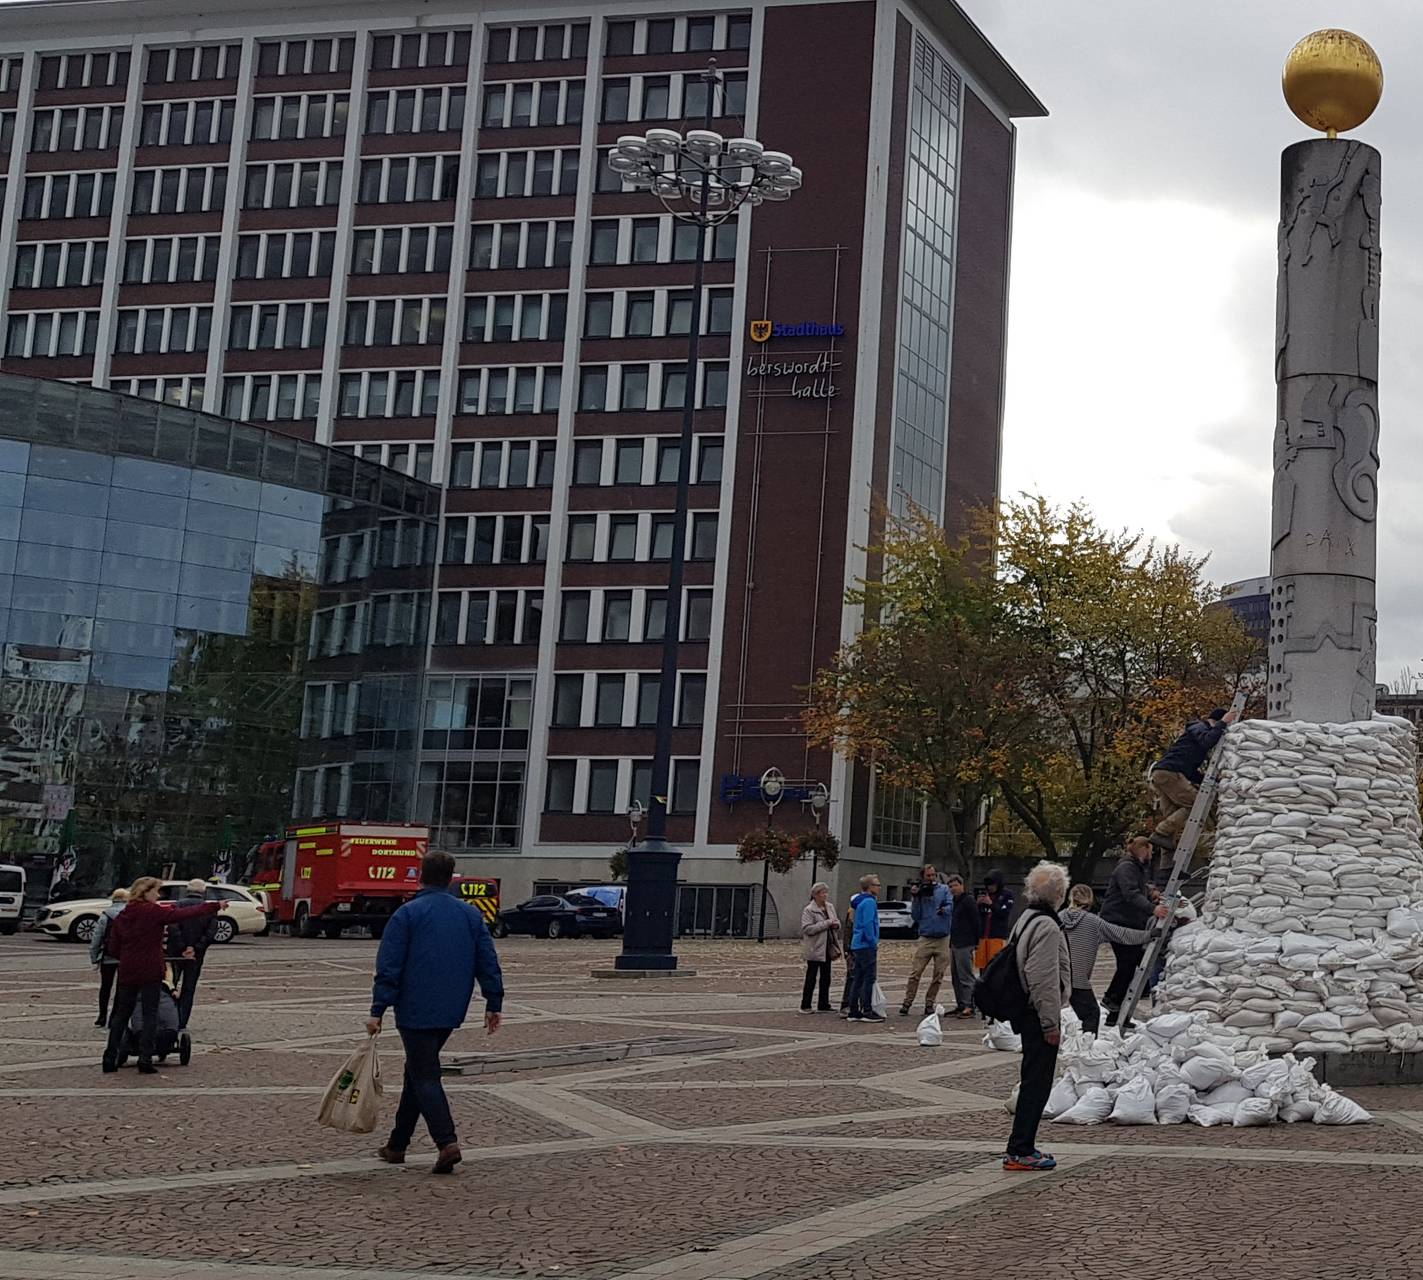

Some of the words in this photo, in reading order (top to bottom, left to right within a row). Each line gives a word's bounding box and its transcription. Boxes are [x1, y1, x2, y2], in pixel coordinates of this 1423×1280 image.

[774, 321, 844, 337] Stadthaus
[747, 351, 842, 376] berswordt-
[792, 376, 835, 399] halle
[376, 866, 396, 879] 112
[469, 883, 486, 896] 112
